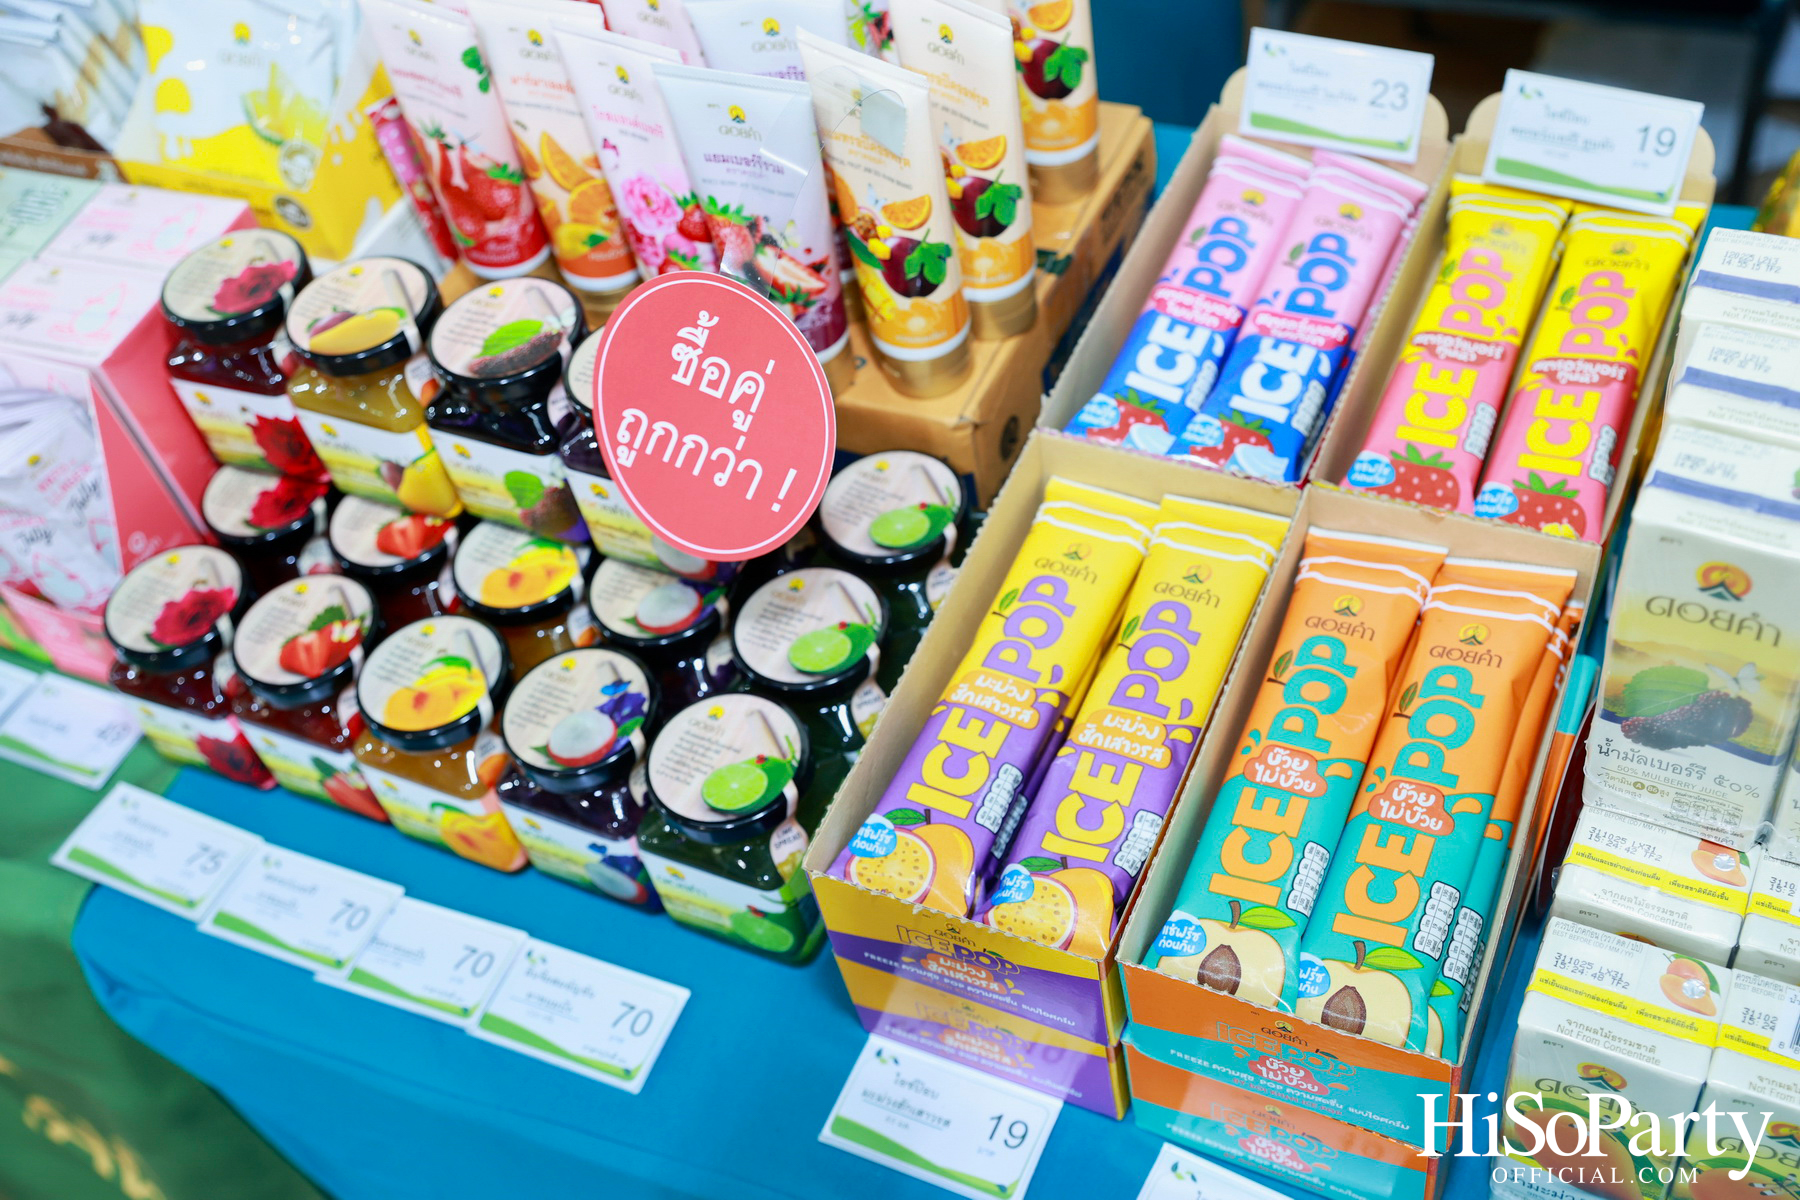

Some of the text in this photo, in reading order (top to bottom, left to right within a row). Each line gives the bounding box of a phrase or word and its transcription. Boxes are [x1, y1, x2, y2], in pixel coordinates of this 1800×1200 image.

[1370, 78, 1410, 112] 23
[1638, 123, 1677, 157] 19
[1124, 315, 1213, 404] ICE
[1183, 215, 1256, 299] POP
[1229, 337, 1318, 424] ICE
[1284, 232, 1357, 318] POP
[1395, 247, 1515, 450] ICE POP
[671, 310, 775, 432] ซื้อคู่
[1517, 270, 1637, 477] ICE POP
[616, 408, 798, 513] ถูกกว่า !
[1034, 557, 1098, 585] ดอยคำ
[1153, 581, 1221, 609] ดอยคำ
[1304, 614, 1376, 642] ดอยคำ
[1645, 595, 1782, 648] ดอยคำ
[1429, 644, 1504, 669] ดอยคำ
[905, 575, 1077, 820] ICE POP
[975, 673, 1030, 703] มะม่วง
[1041, 600, 1202, 863] ICE POP
[1103, 711, 1160, 740] มะม่วง
[1208, 634, 1359, 907] ICE POP
[1267, 746, 1309, 772] บ๊วย
[1597, 738, 1760, 799] น้ำมัลเบอร์รี ๕๐%
[1255, 762, 1317, 793] ไม่บ๊วย
[1616, 765, 1729, 799] 50% MULBERRY JUICE
[1332, 665, 1486, 947] ICE POP
[1392, 781, 1436, 807] บ๊วย
[1380, 797, 1444, 831] ไม่บ๊วย
[1589, 826, 1657, 853] 311025 LX31
[1644, 849, 1663, 862] TF2
[184, 842, 228, 875] 75
[1770, 876, 1796, 890] 3110
[1770, 884, 1796, 897] 15:2
[330, 898, 371, 932] 70
[1601, 887, 1689, 921] จากผลไม้ธรรมชาติ
[1158, 937, 1196, 954] ก่อนกิน
[1161, 924, 1202, 942] แช่ฟรีซ
[1552, 929, 1568, 937] BEST
[1569, 933, 1592, 945] BEFORE
[454, 944, 496, 978] 70
[1555, 952, 1624, 980] 311025 LX31
[1611, 976, 1630, 990] TF2
[611, 1000, 654, 1037] 70
[1741, 1014, 1777, 1032] 15:24
[1742, 1007, 1779, 1025] 31102
[1556, 1024, 1662, 1066] Not From Concentrate
[1566, 1017, 1657, 1055] จากผลไม้ธรรมชาติ
[1257, 1063, 1319, 1093] ไม่บ๊วย
[1265, 1057, 1305, 1077] บ๊วย
[1259, 1079, 1283, 1091] POP
[1748, 1082, 1796, 1103] Not From
[988, 1113, 1029, 1149] 19
